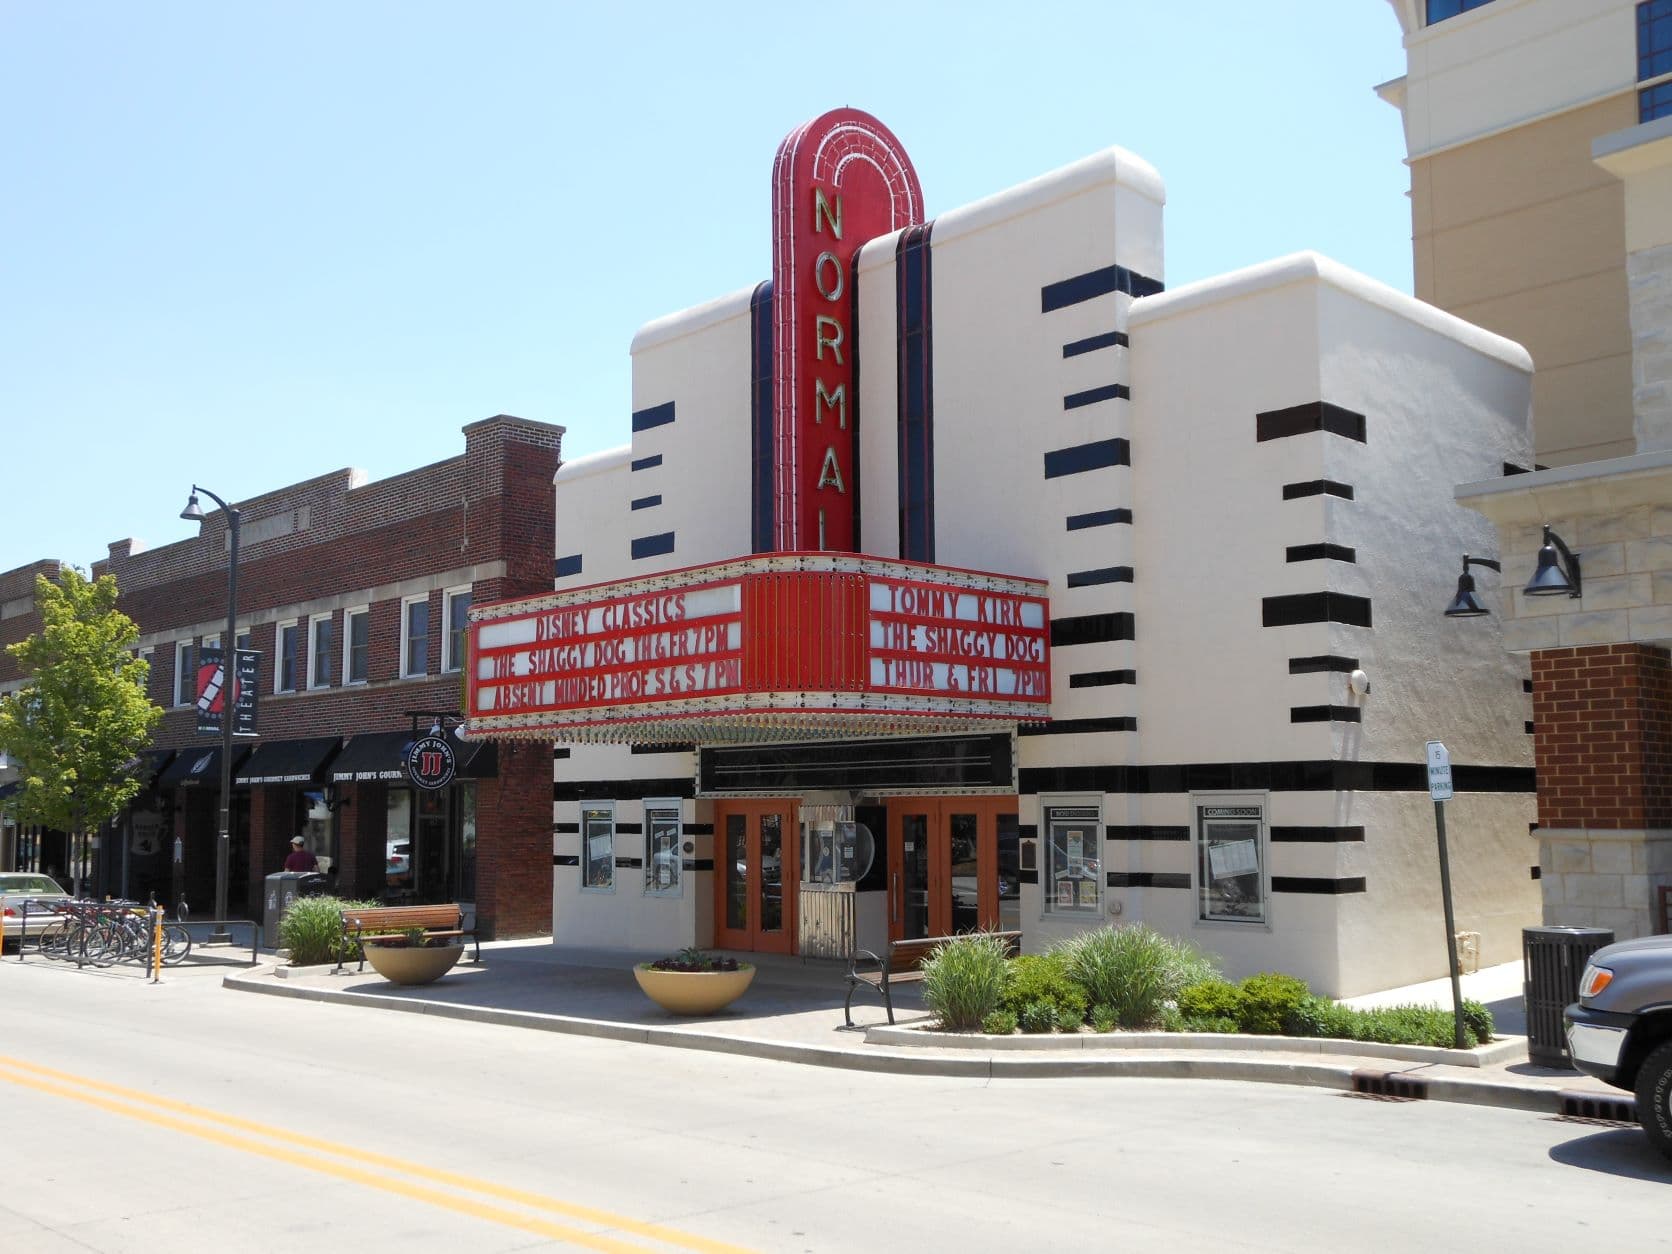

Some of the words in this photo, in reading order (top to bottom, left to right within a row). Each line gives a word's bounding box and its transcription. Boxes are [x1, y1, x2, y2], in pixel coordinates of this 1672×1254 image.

[536, 608, 590, 641] DISNEY
[602, 594, 686, 633] CLASSICS
[889, 586, 960, 618] TOMMY
[978, 597, 1024, 627] KIRK
[493, 652, 516, 679] THE
[528, 644, 587, 675] SHAGGY
[593, 638, 626, 668] DOG
[881, 622, 916, 650] THE
[925, 627, 995, 658] SHAGGY
[1005, 633, 1040, 663] DOG
[240, 655, 254, 731] THEATER
[494, 680, 546, 711] ABSENT
[555, 675, 606, 705] MINDED
[611, 670, 649, 699] PROF
[655, 666, 666, 694] S
[670, 666, 681, 693] &
[685, 664, 697, 691] S
[882, 659, 934, 689] THUR
[947, 662, 960, 690] &
[968, 665, 997, 694] FRI
[411, 741, 430, 763] JIMMY
[433, 741, 451, 763] JOHN'S
[421, 752, 442, 775] JJ
[333, 772, 353, 782] JIMMY
[355, 771, 377, 782] JOHN'S
[1208, 808, 1234, 816] COMING
[1234, 808, 1257, 816] SOON
